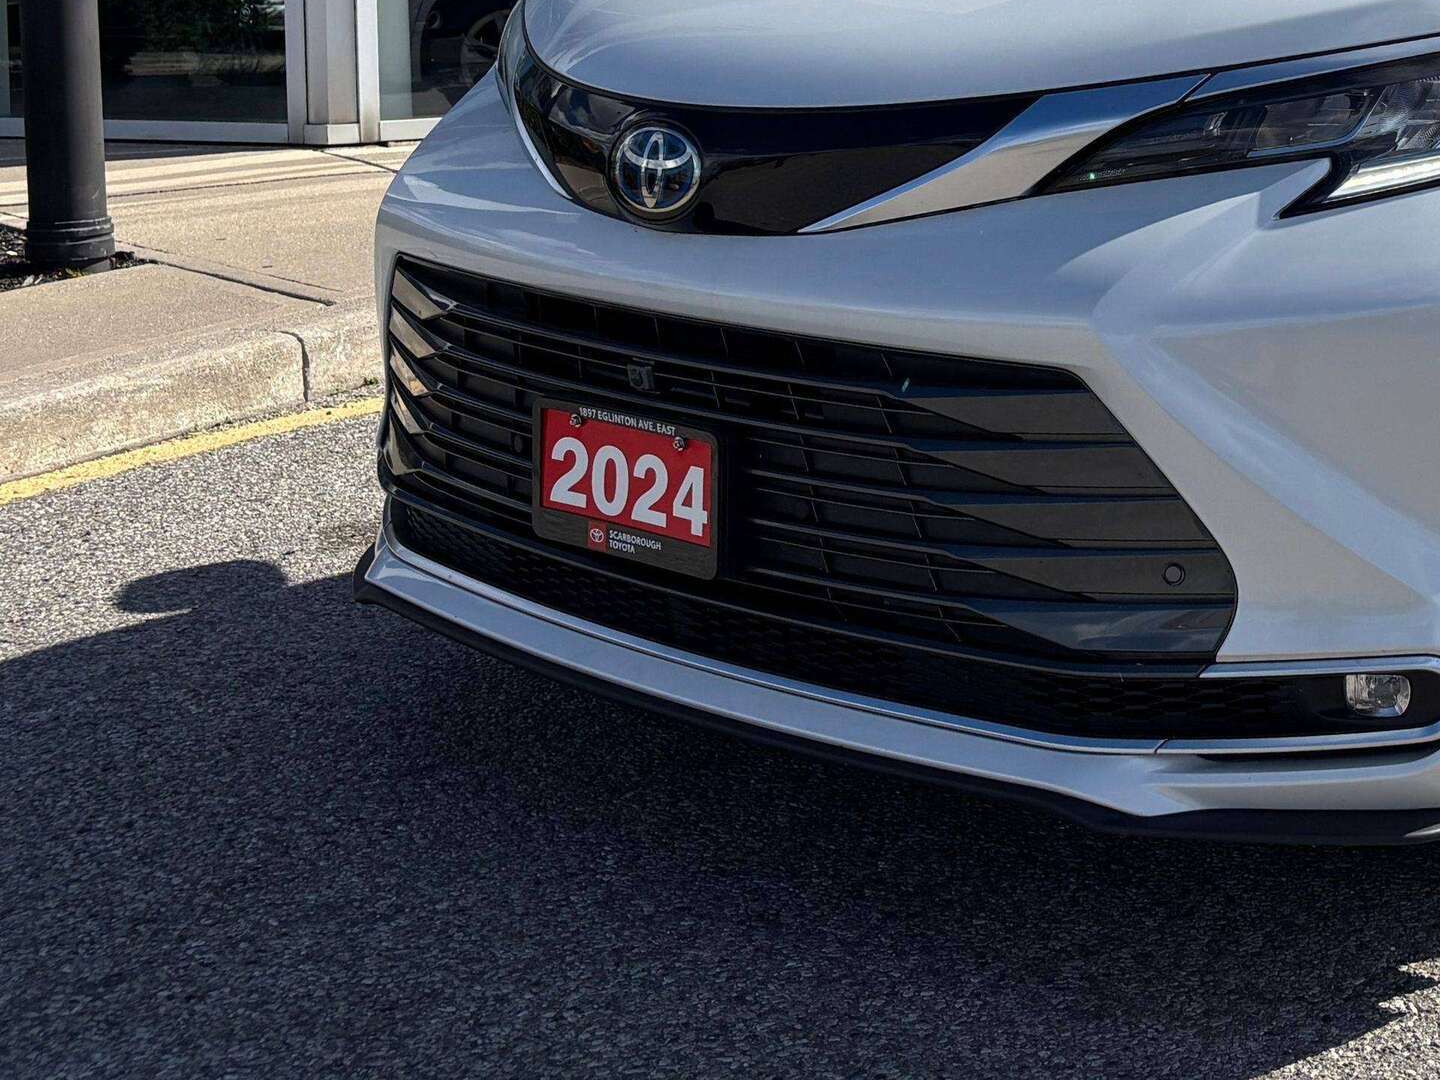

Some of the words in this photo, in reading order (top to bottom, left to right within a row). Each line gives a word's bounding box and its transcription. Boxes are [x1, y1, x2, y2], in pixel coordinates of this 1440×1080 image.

[580, 407, 596, 419] 1897
[597, 411, 637, 428] EGLINTON
[656, 423, 676, 436] EAST
[550, 437, 708, 536] 2024
[609, 530, 662, 550] SCARBOROUGH
[609, 539, 636, 554] TOYOTA
